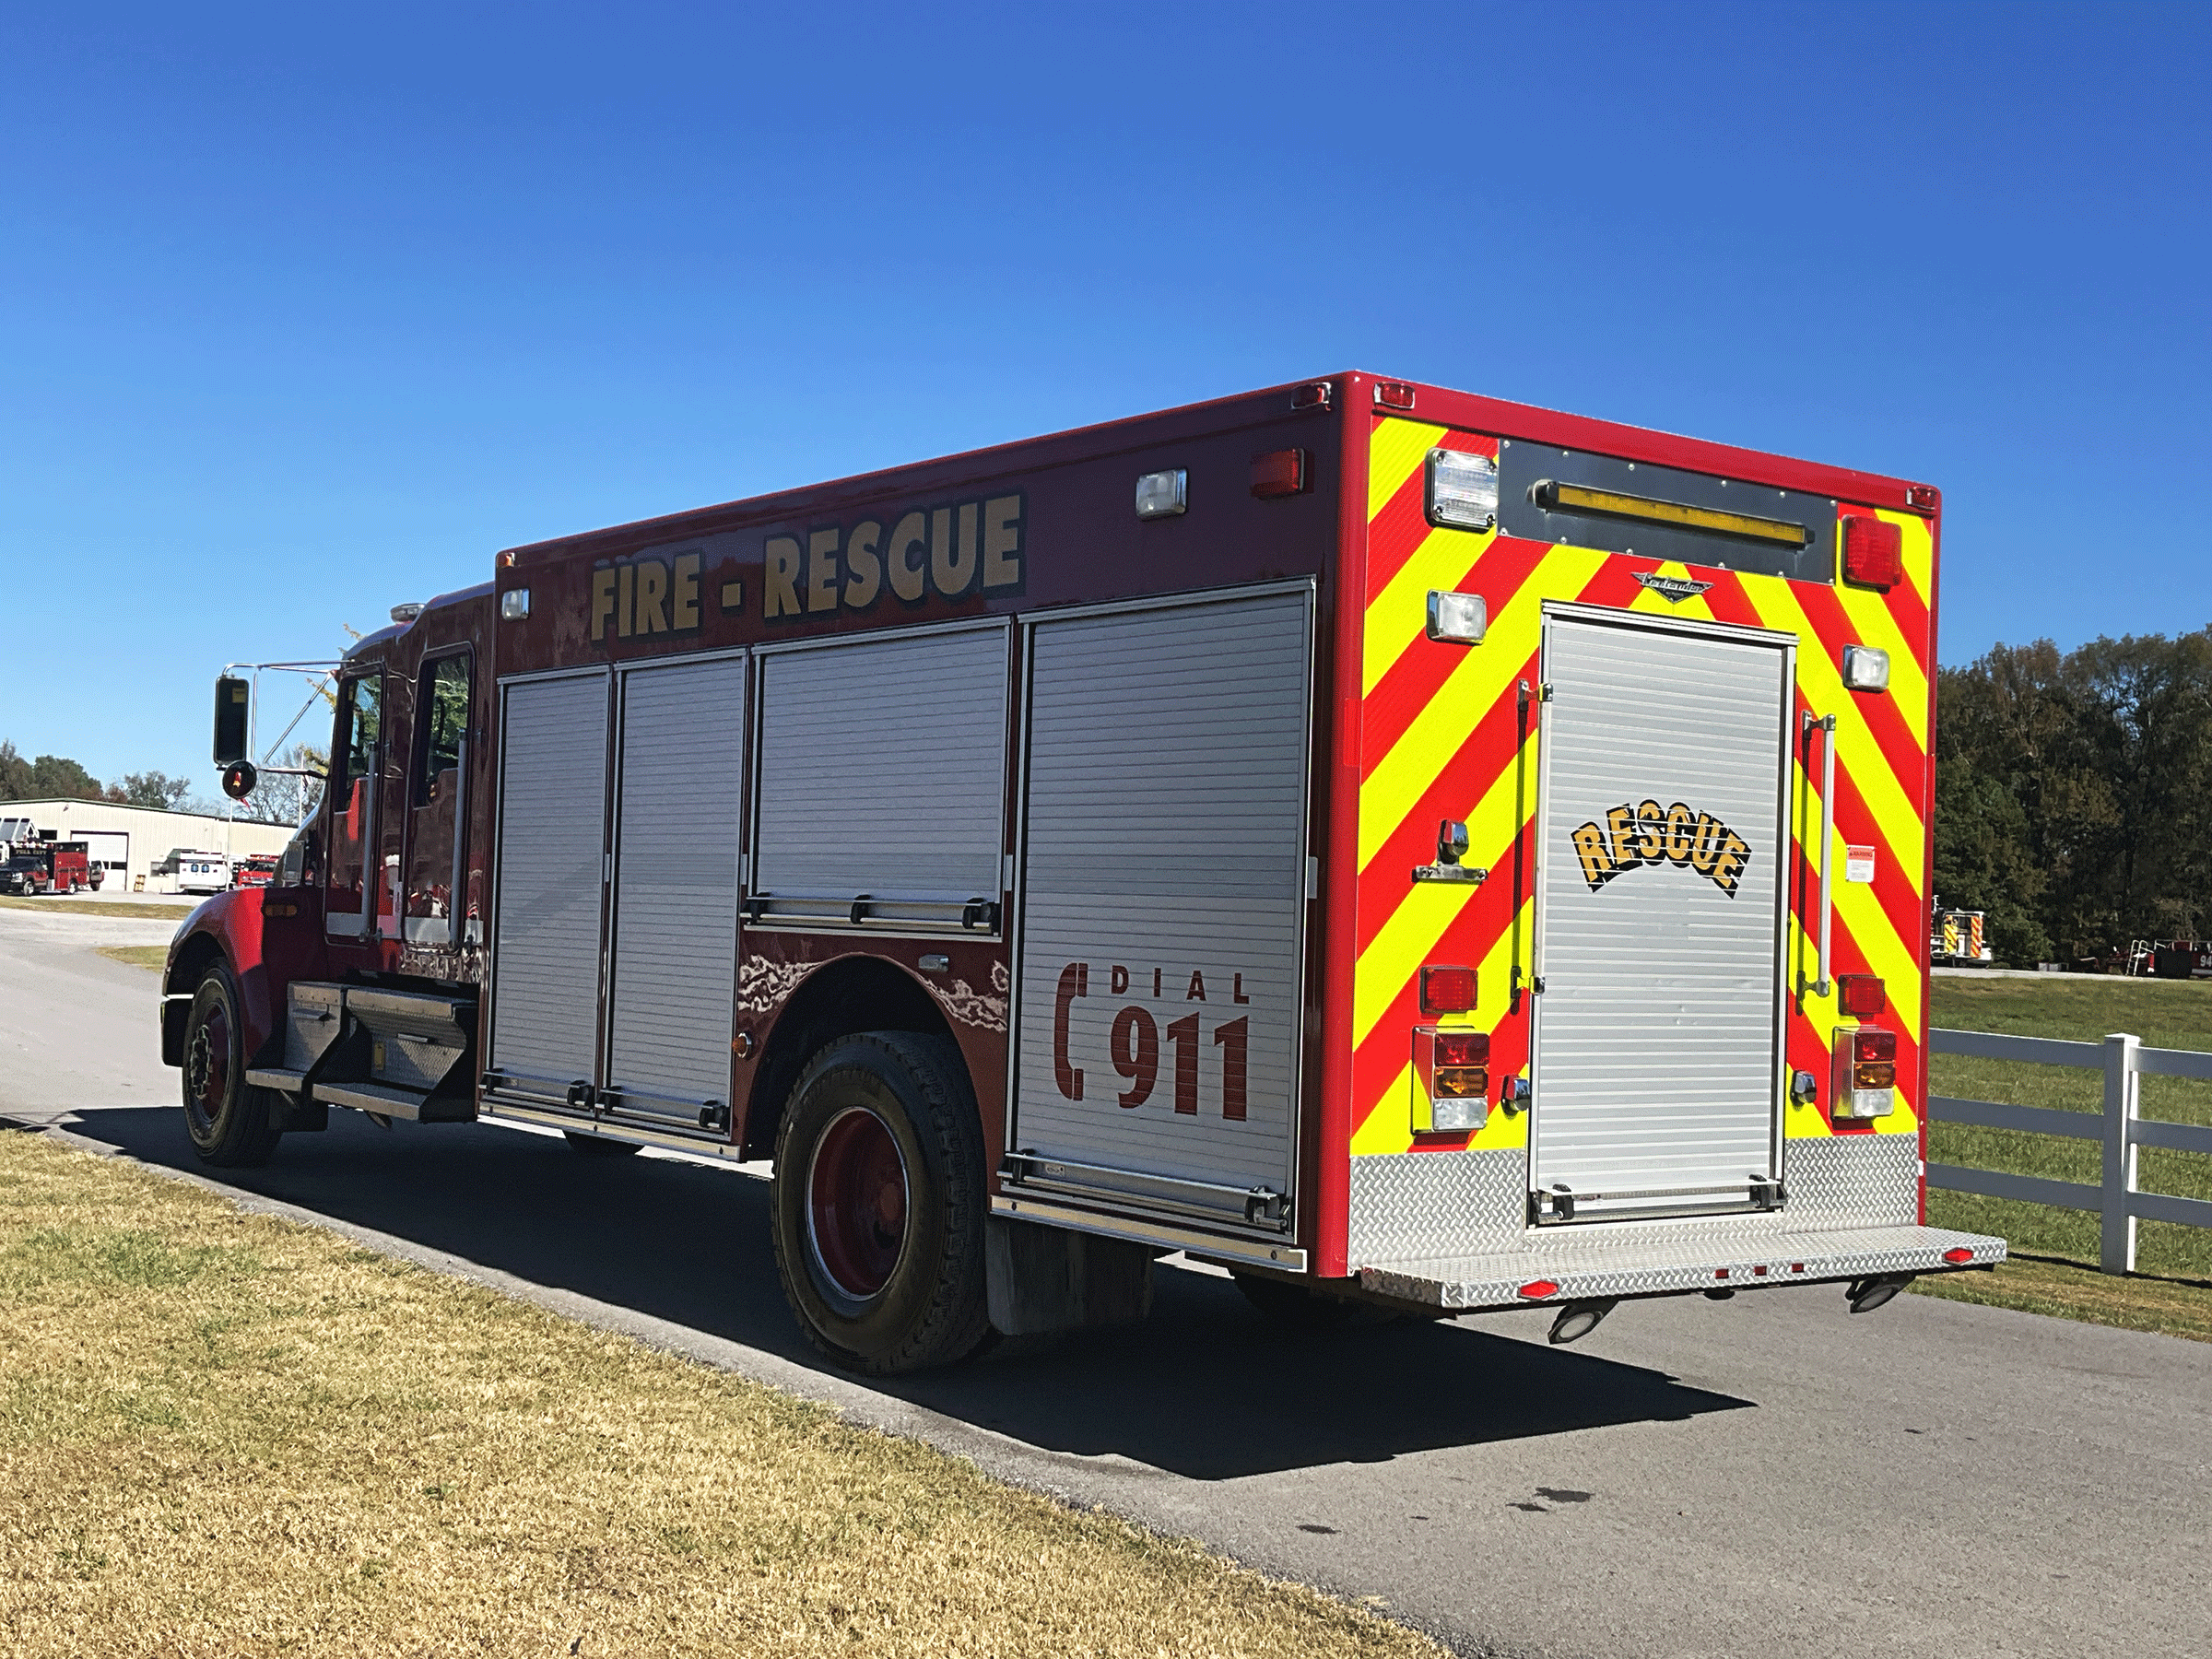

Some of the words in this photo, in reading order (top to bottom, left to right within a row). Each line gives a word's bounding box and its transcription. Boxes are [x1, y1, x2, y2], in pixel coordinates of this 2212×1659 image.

[591, 554, 700, 641] FIRE
[763, 495, 1020, 618] RESCUE
[1571, 799, 1752, 900] RESCUE
[1111, 965, 1250, 1005] DIAL
[1111, 1006, 1249, 1122] 911
